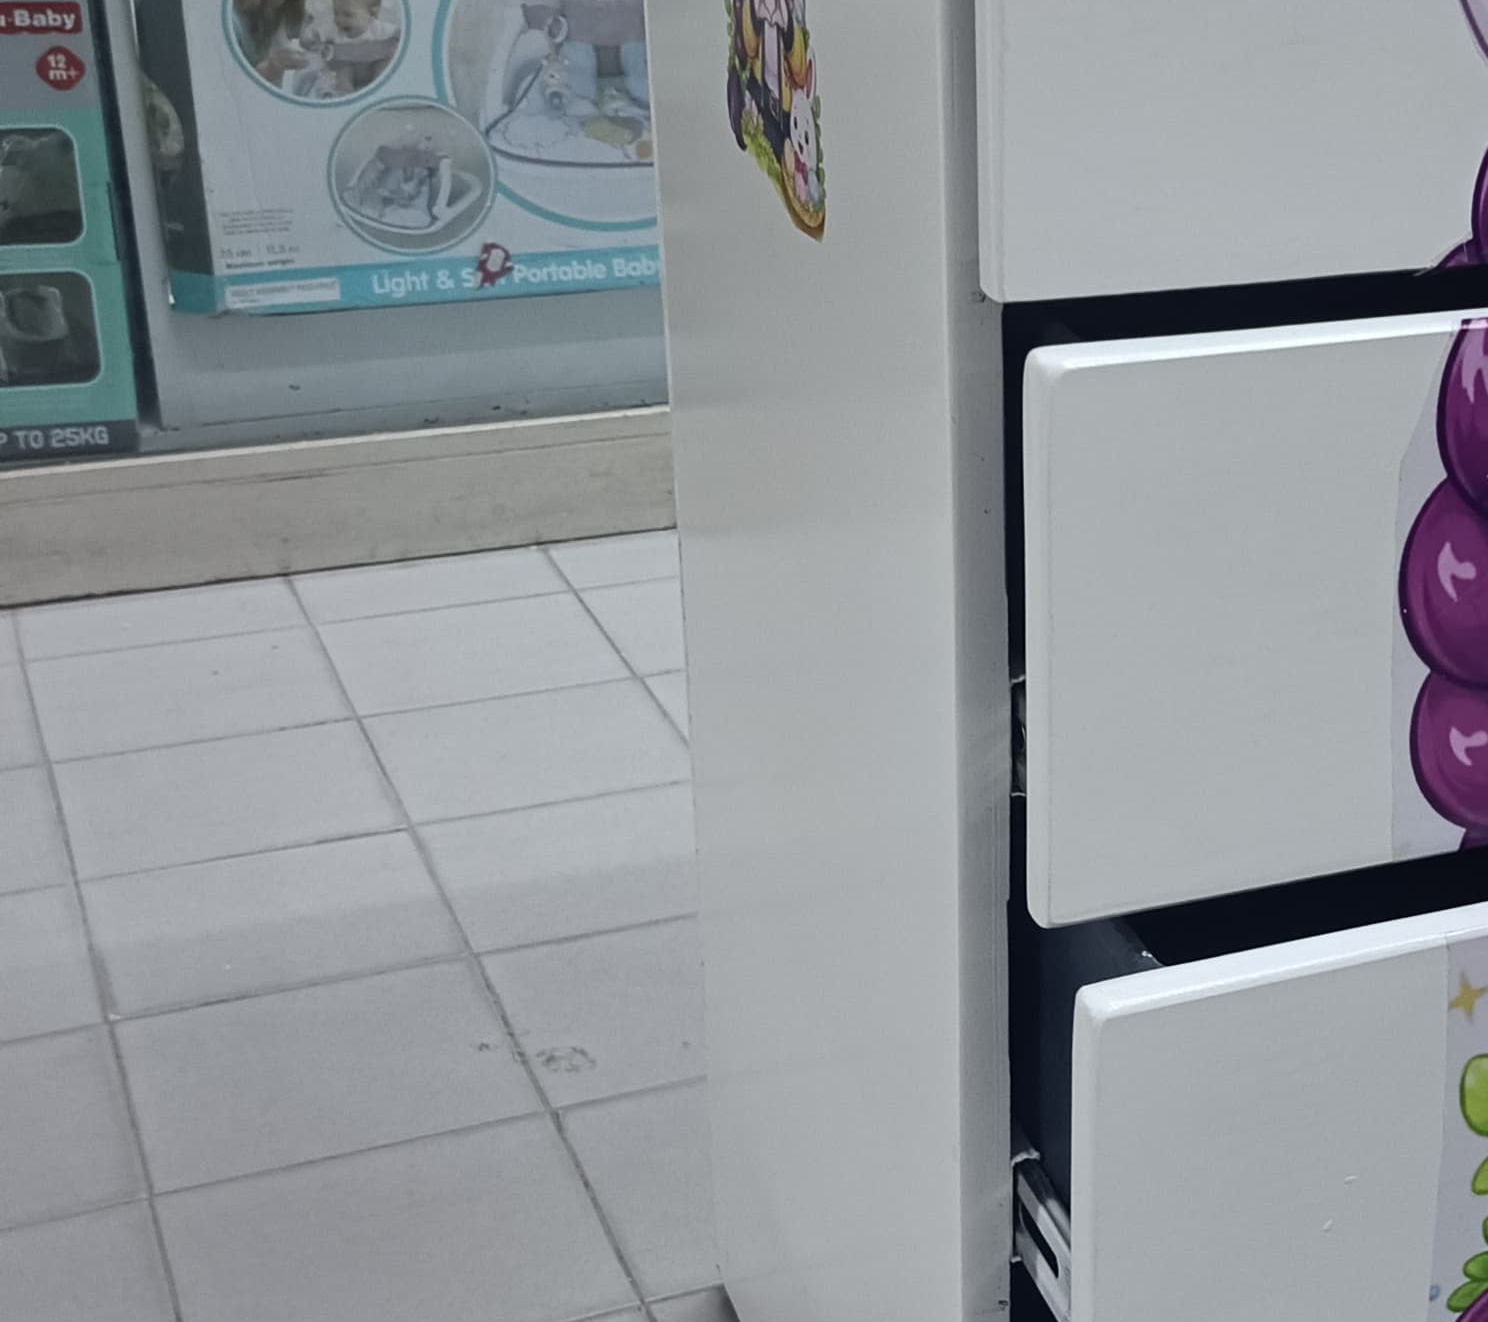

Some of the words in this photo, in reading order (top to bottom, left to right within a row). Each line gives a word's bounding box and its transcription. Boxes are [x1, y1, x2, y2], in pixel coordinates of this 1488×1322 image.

[47, 54, 67, 69] 12
[373, 271, 433, 297] Light
[439, 271, 456, 289] &
[514, 259, 607, 284] Portable
[13, 429, 45, 450] TO
[50, 425, 110, 448] 25KG
